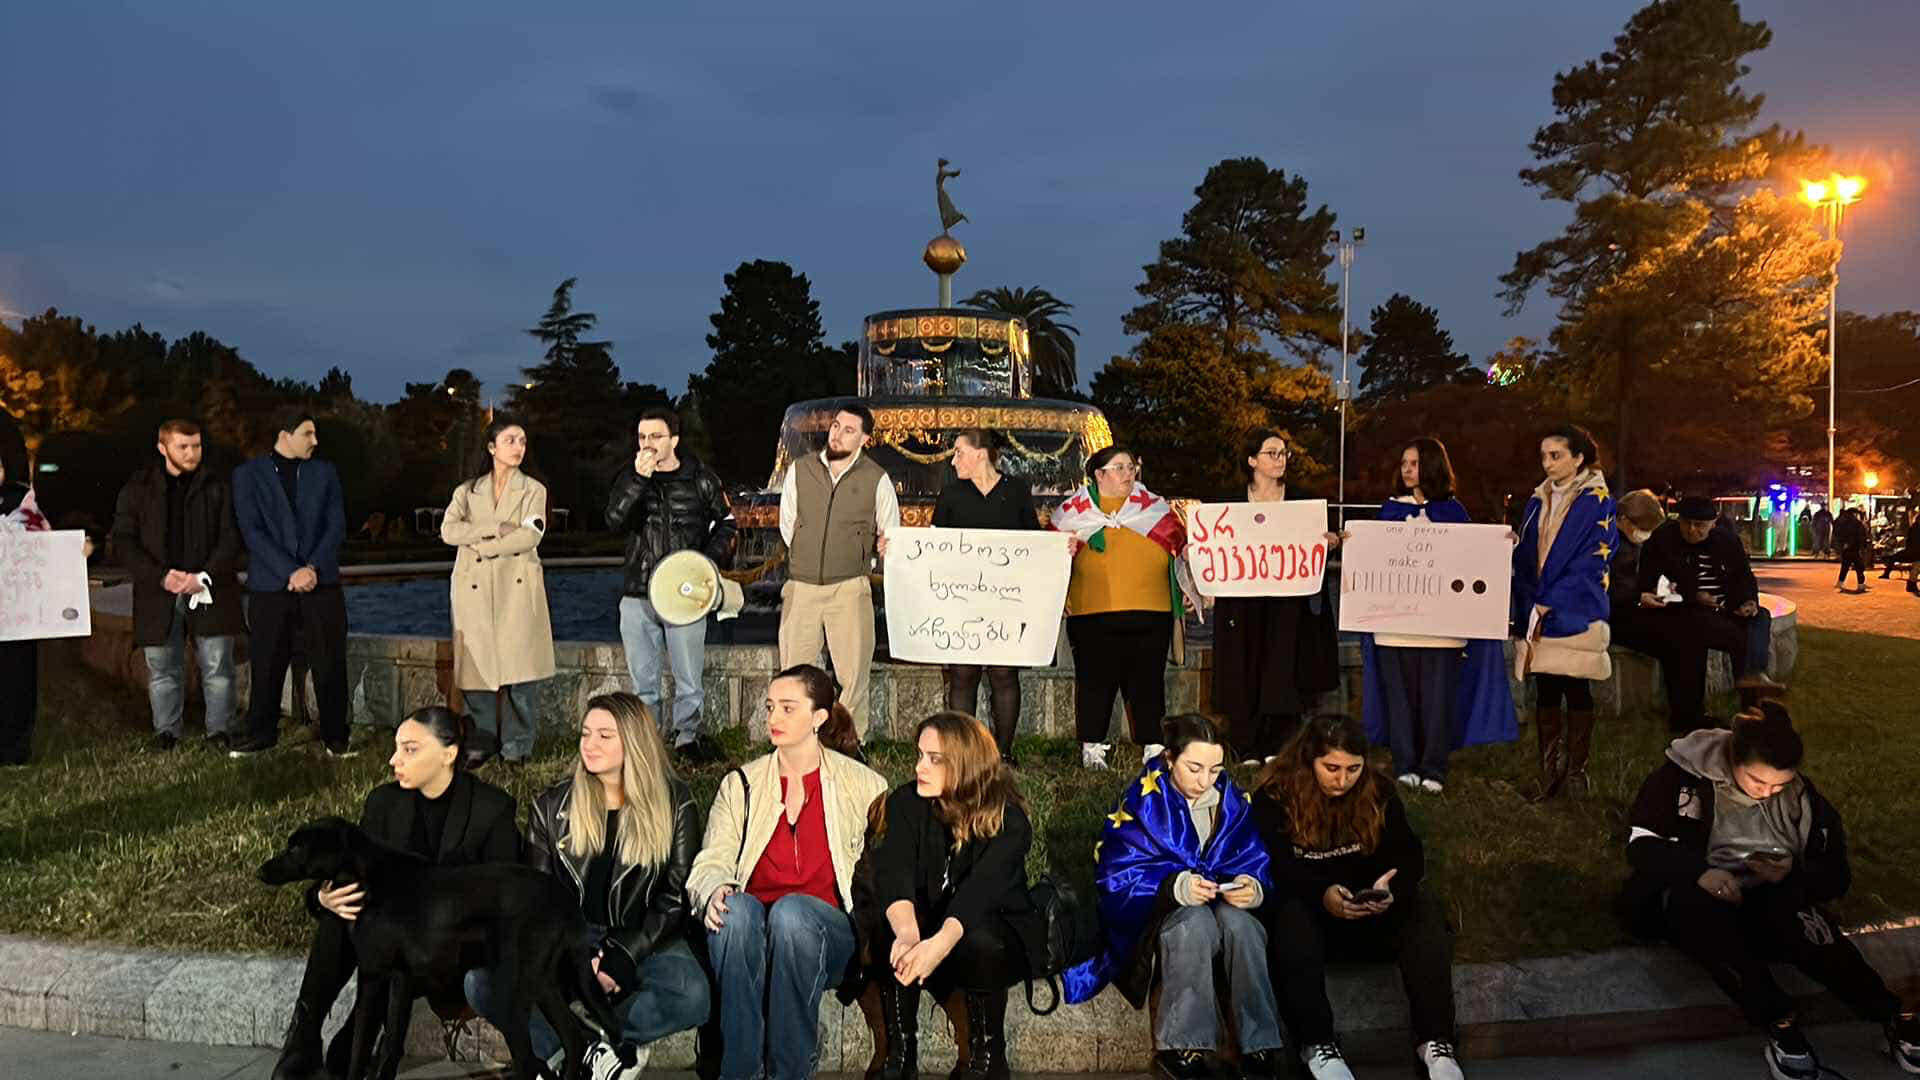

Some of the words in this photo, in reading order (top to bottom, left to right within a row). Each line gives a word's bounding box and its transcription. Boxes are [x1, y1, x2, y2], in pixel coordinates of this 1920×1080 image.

[1192, 505, 1235, 542] არ
[906, 531, 1031, 566] ვითხოვთ
[1388, 556, 1419, 568] make
[1427, 559, 1435, 568] a
[1406, 542, 1433, 553] can
[929, 570, 1024, 603] ხელახალ
